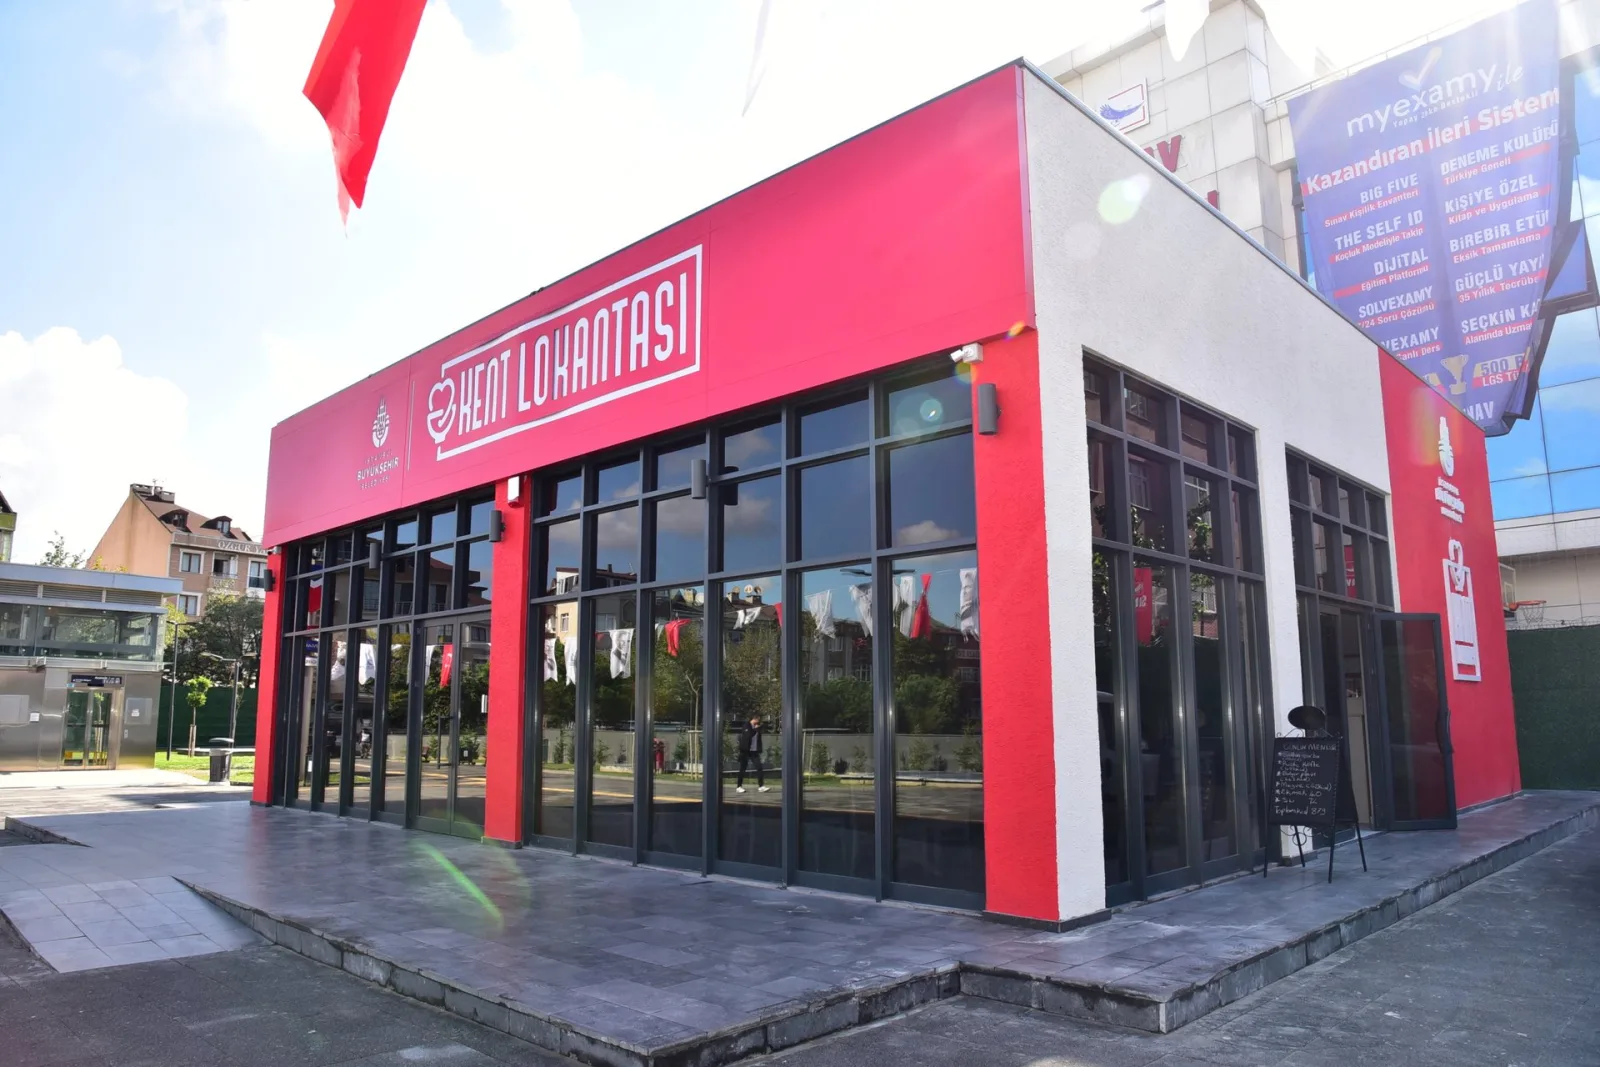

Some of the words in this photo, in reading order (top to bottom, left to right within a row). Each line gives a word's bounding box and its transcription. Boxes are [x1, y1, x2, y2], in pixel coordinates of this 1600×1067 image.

[1497, 64, 1524, 92] ile
[1346, 64, 1496, 137] myexamy
[1305, 139, 1424, 195] Kazandıran
[1440, 144, 1499, 176] DENEME
[1444, 167, 1479, 186] Türkiye
[1481, 156, 1511, 173] Geneli
[1360, 185, 1383, 204] BIG
[1387, 173, 1419, 194] FIVE
[1445, 186, 1494, 214] KİŞİYE
[1499, 174, 1538, 196] ÖZEL
[1324, 214, 1348, 228] Sınav
[1377, 189, 1419, 208] Envanteri
[1448, 210, 1472, 225] Kitap
[1475, 207, 1487, 216] ve
[1488, 191, 1539, 213] Uygulama
[1334, 230, 1362, 250] THE
[1366, 216, 1402, 240] SELF
[1407, 210, 1423, 226] ID
[1334, 248, 1361, 262] Koçluk
[1362, 235, 1400, 253] Modeliyle
[1401, 227, 1424, 240] Takip
[1449, 223, 1511, 253] BİREBİR
[1373, 248, 1429, 276] DİJİTAL
[1453, 250, 1479, 264] Eksik
[1481, 232, 1541, 256] Tamamlama
[1361, 278, 1387, 291] Eğitim
[1389, 265, 1429, 283] Platformu
[1455, 263, 1503, 292] GÜÇLÜ
[1358, 286, 1433, 318] SOLVEXAMY
[1459, 293, 1471, 303] 35
[1472, 286, 1496, 299] Yıllık
[1377, 315, 1398, 324] Soru
[1400, 303, 1435, 320] Çözümü
[1461, 308, 1516, 334] SEÇKİN
[1421, 344, 1441, 356] Ders
[1465, 328, 1504, 345] Alanında
[458, 349, 512, 436] KENT
[517, 272, 688, 413] LOKANTASI
[1481, 358, 1509, 376] 500
[1482, 373, 1504, 387] LGS
